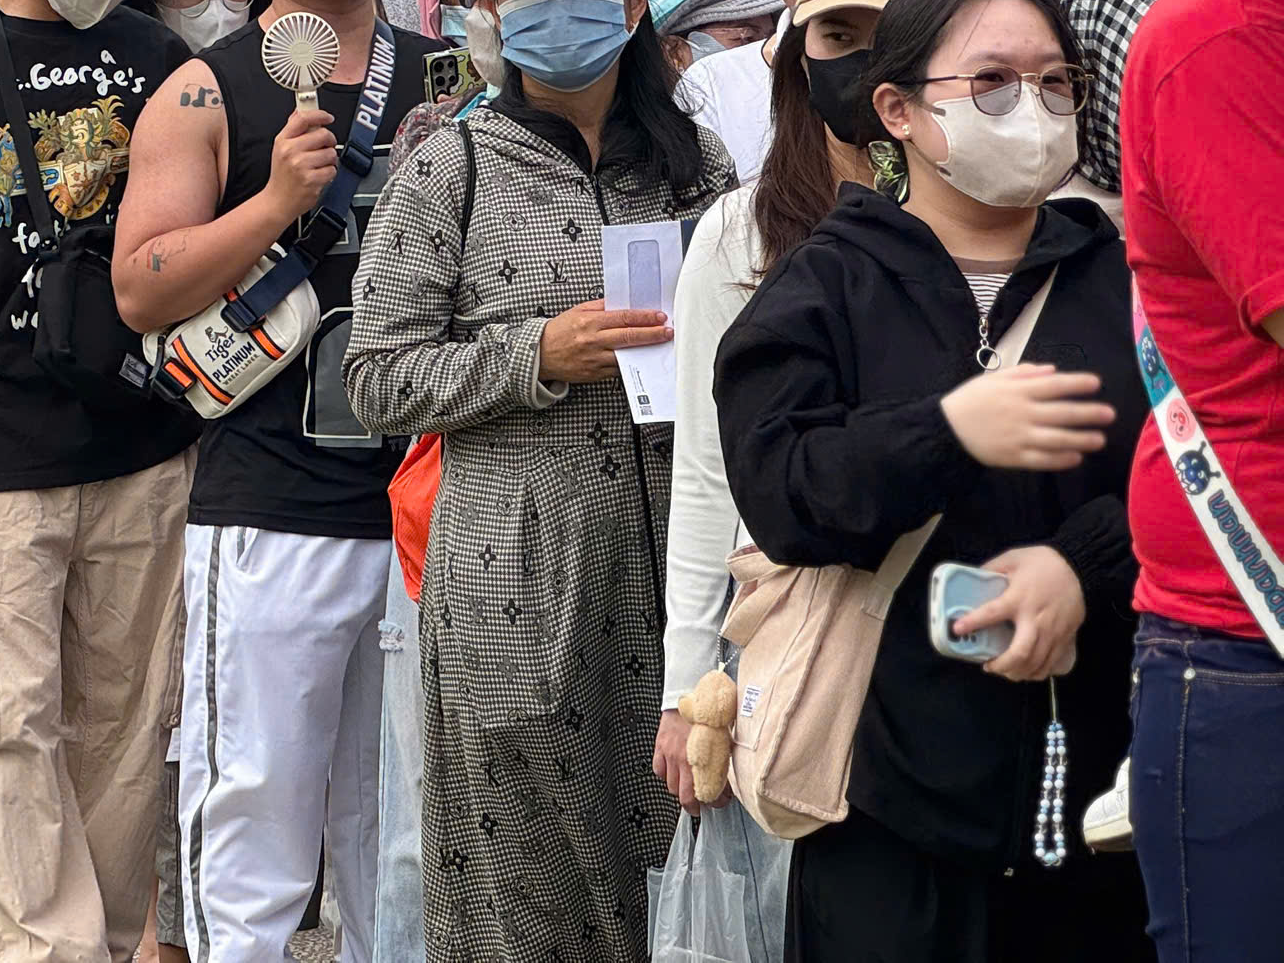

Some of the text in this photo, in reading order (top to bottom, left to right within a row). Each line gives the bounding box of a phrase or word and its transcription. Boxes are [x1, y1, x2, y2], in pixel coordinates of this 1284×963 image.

[356, 34, 395, 130] PLATINUM
[205, 333, 236, 362] Tiger
[212, 341, 256, 383] PLATINUM
